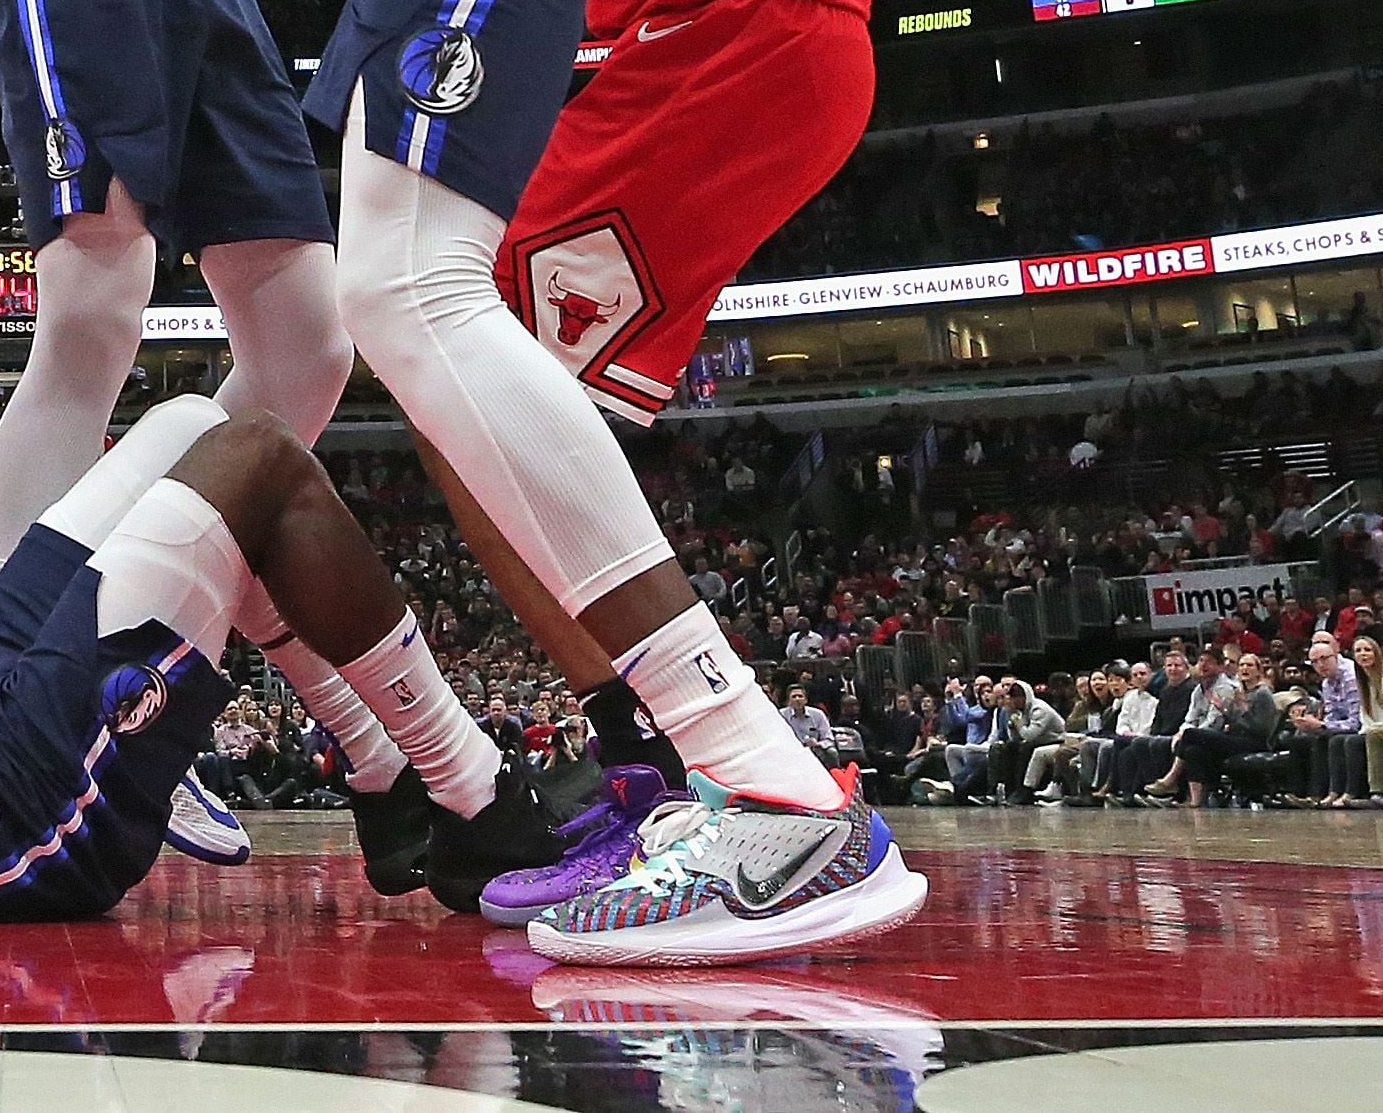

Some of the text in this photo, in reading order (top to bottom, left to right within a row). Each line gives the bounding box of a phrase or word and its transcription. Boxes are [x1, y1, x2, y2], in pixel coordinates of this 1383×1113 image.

[898, 8, 972, 35] REBOUNDS
[1293, 232, 1354, 252] CHOPS
[1027, 245, 1207, 288] WILDFIRE
[799, 285, 882, 305] GLENVIEW
[893, 273, 1010, 296] SCHAUMBURG
[146, 318, 199, 331] CHOPS
